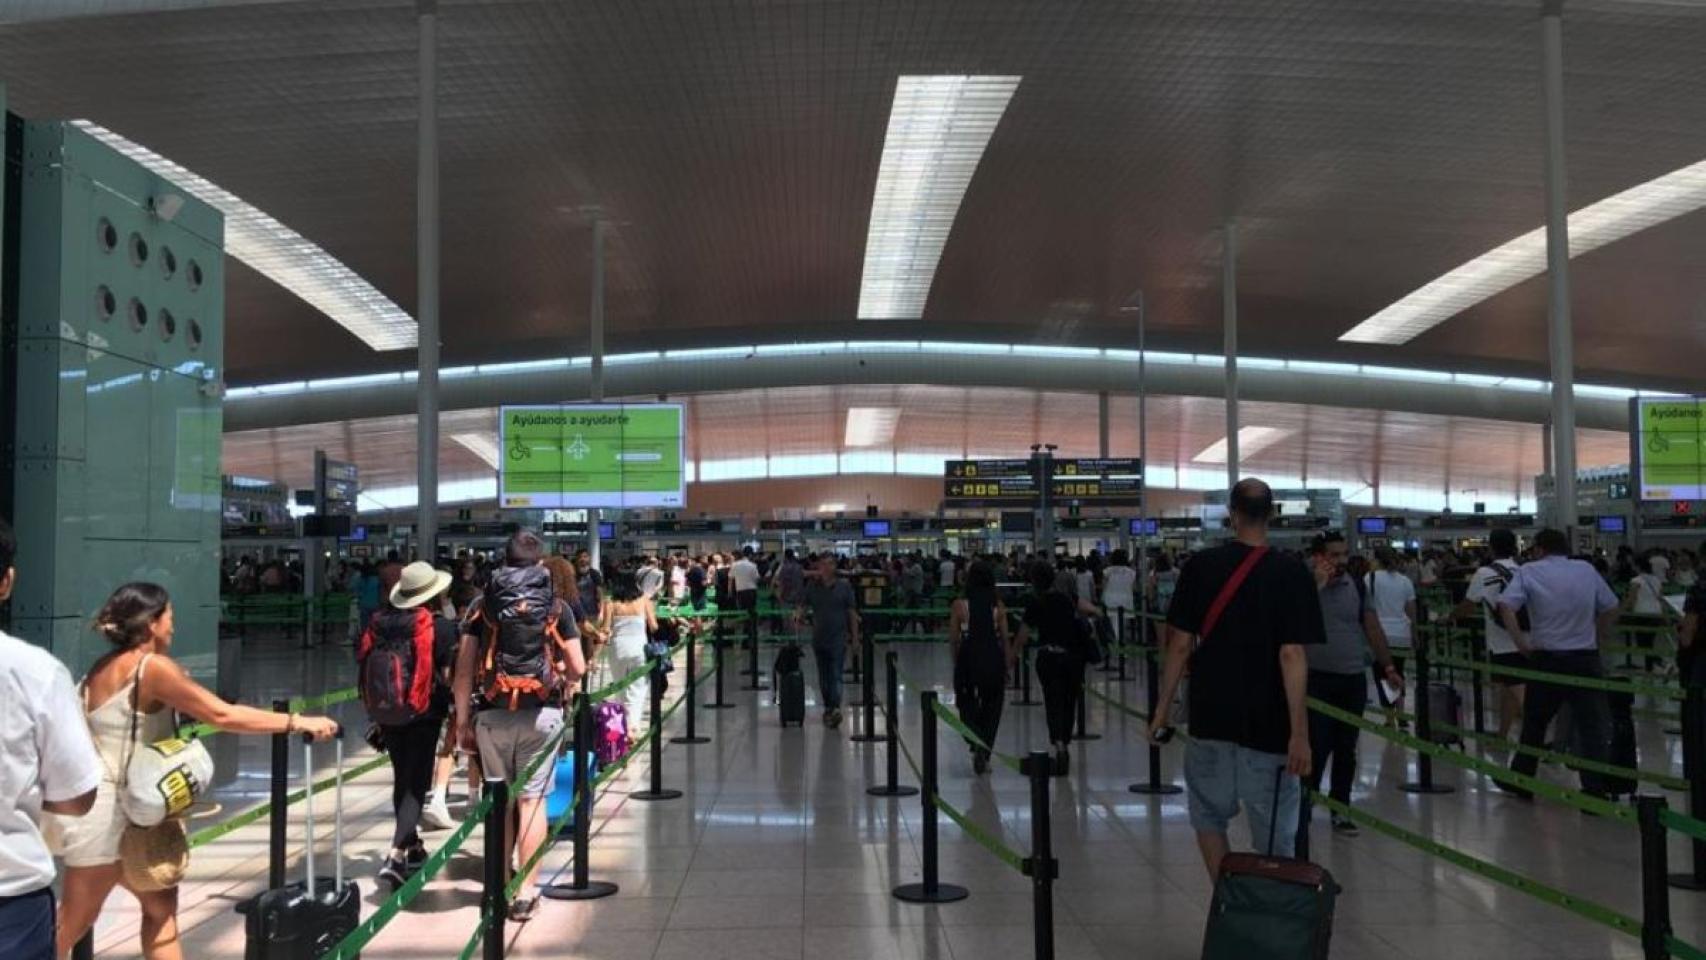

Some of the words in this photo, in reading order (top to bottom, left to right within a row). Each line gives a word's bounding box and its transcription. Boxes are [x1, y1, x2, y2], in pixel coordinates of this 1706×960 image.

[512, 414, 567, 427] Ayúdanos
[570, 416, 577, 425] a
[580, 414, 630, 426] ayudarte
